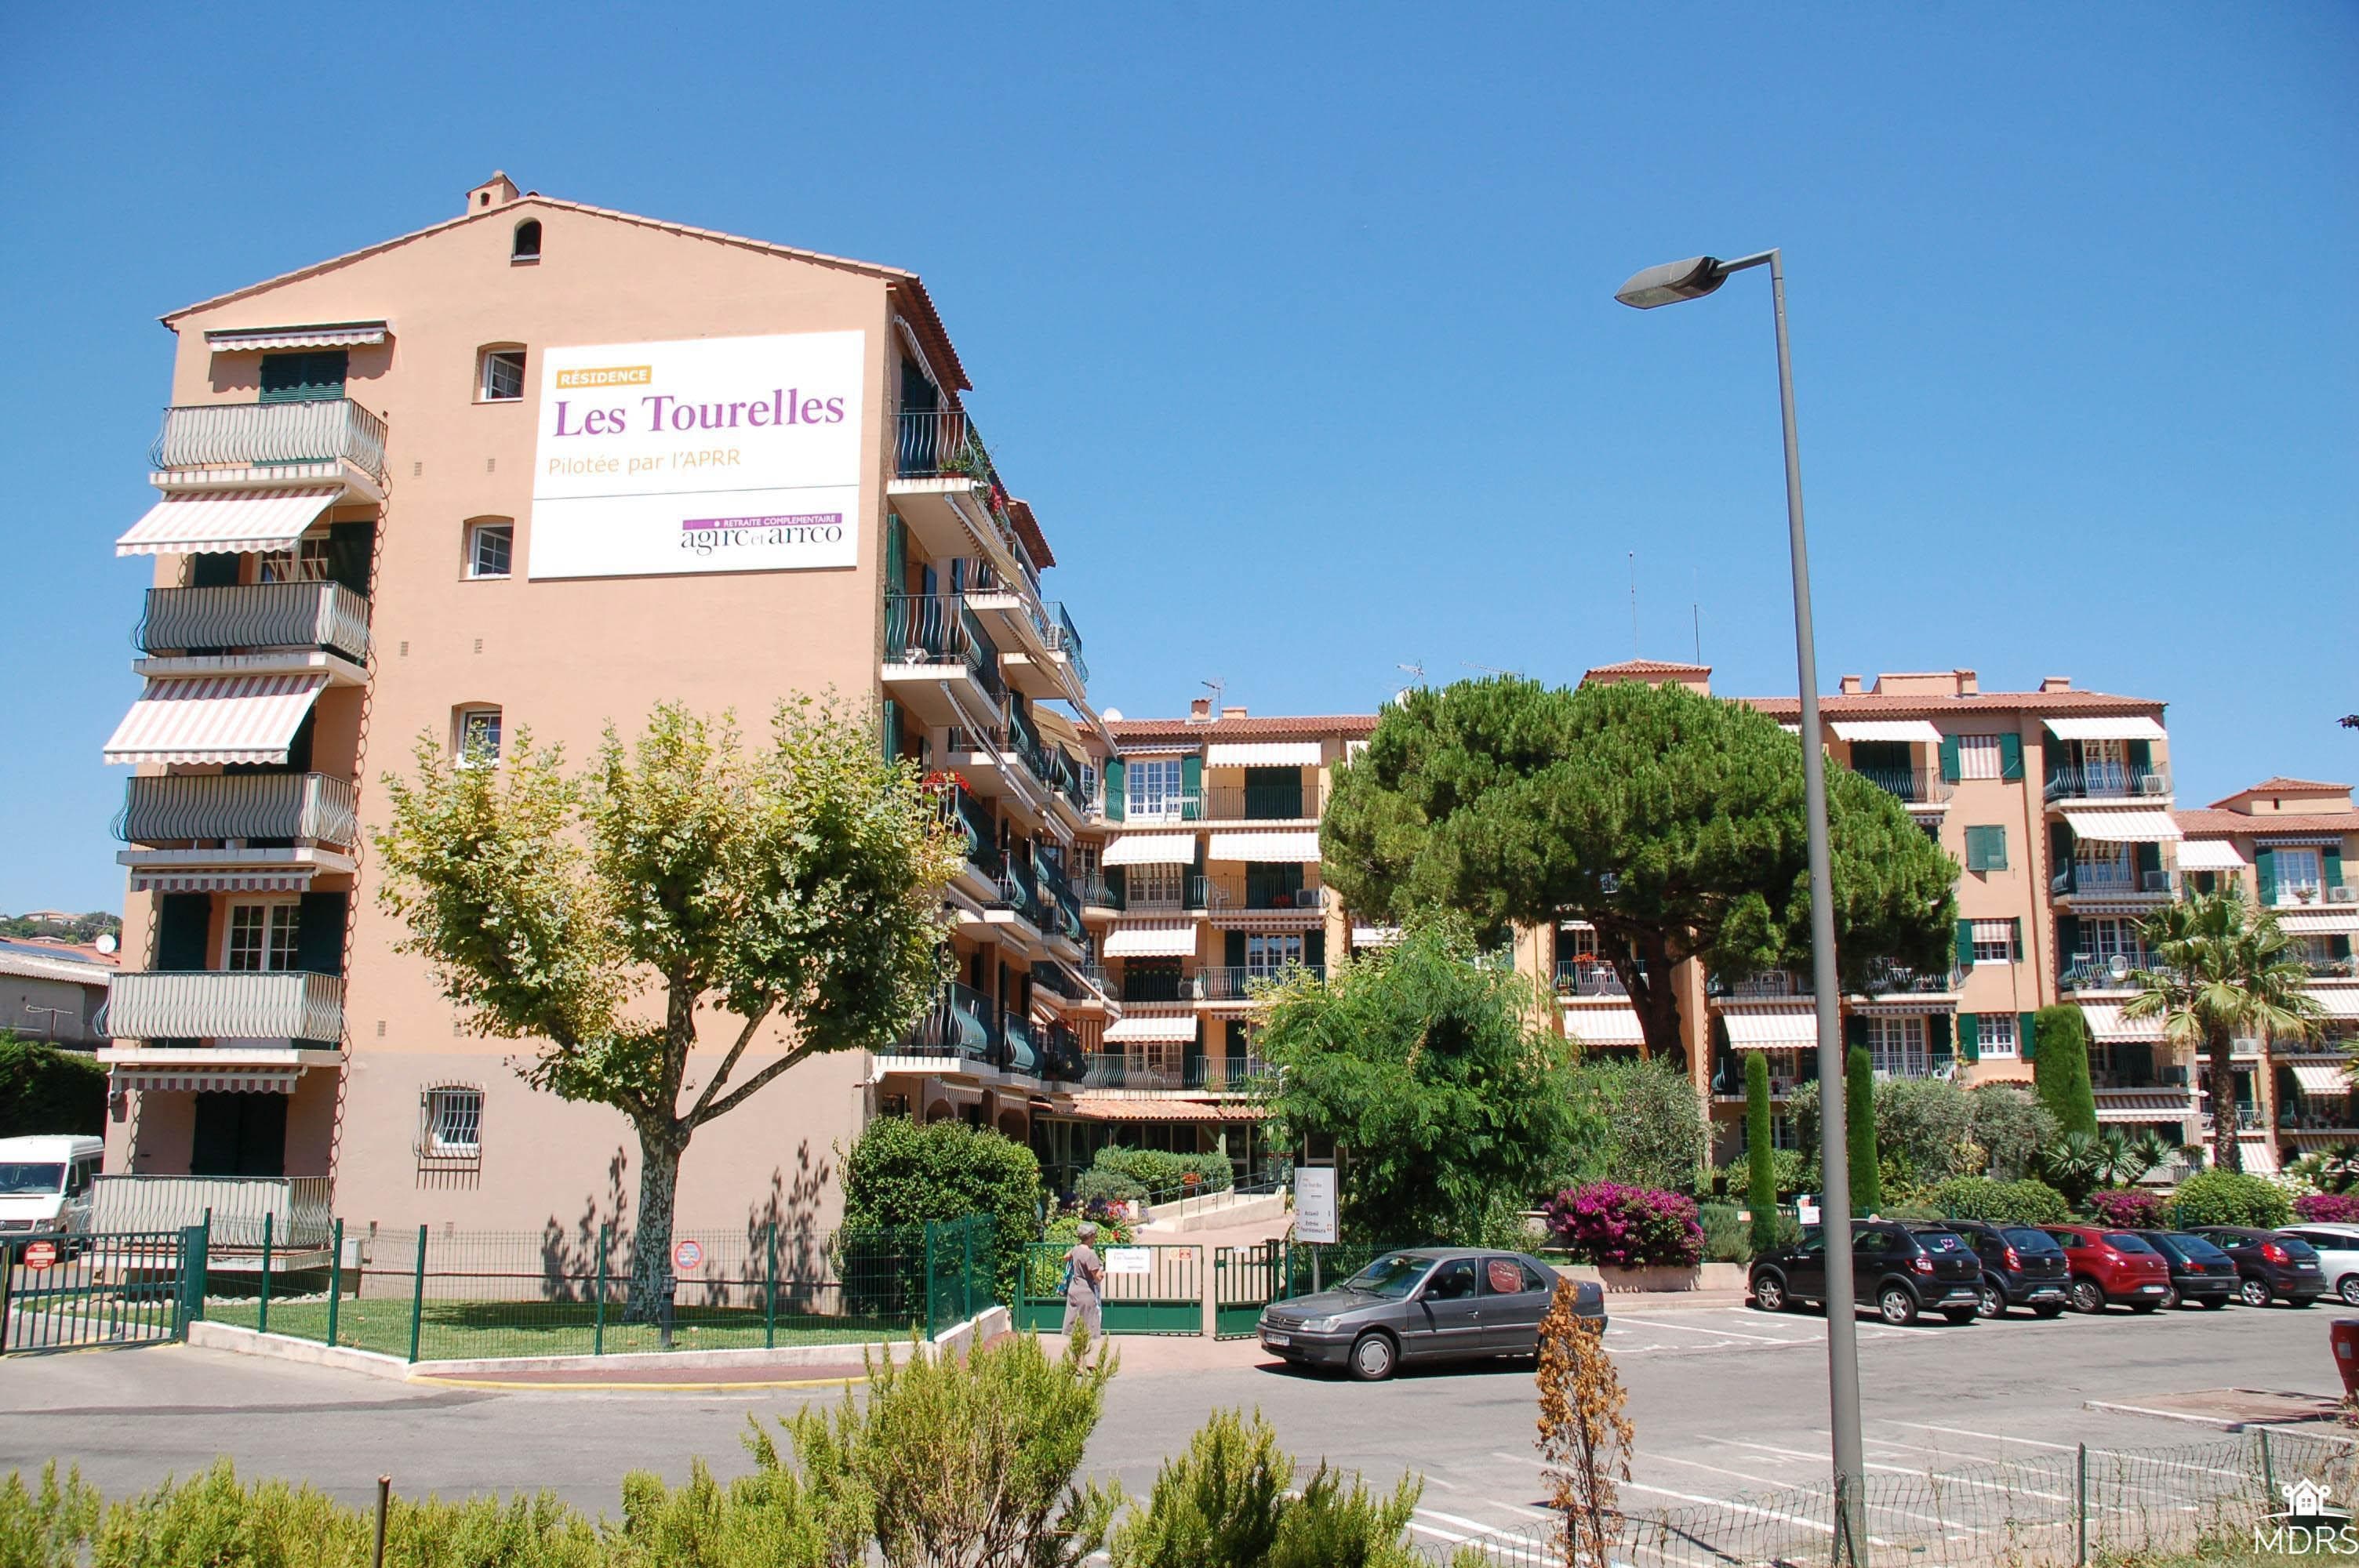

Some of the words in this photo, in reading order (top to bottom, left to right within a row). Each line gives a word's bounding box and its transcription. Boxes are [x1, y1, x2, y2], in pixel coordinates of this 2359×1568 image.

[560, 369, 648, 385] RÉSIDENCE
[553, 401, 626, 437] Les
[642, 387, 845, 432] Tourelles
[549, 454, 620, 475] Pilotée
[628, 457, 664, 476] par
[723, 517, 761, 528] RETRAITE
[681, 528, 749, 556] agirc
[751, 534, 765, 546] et
[769, 525, 843, 545] arrco
